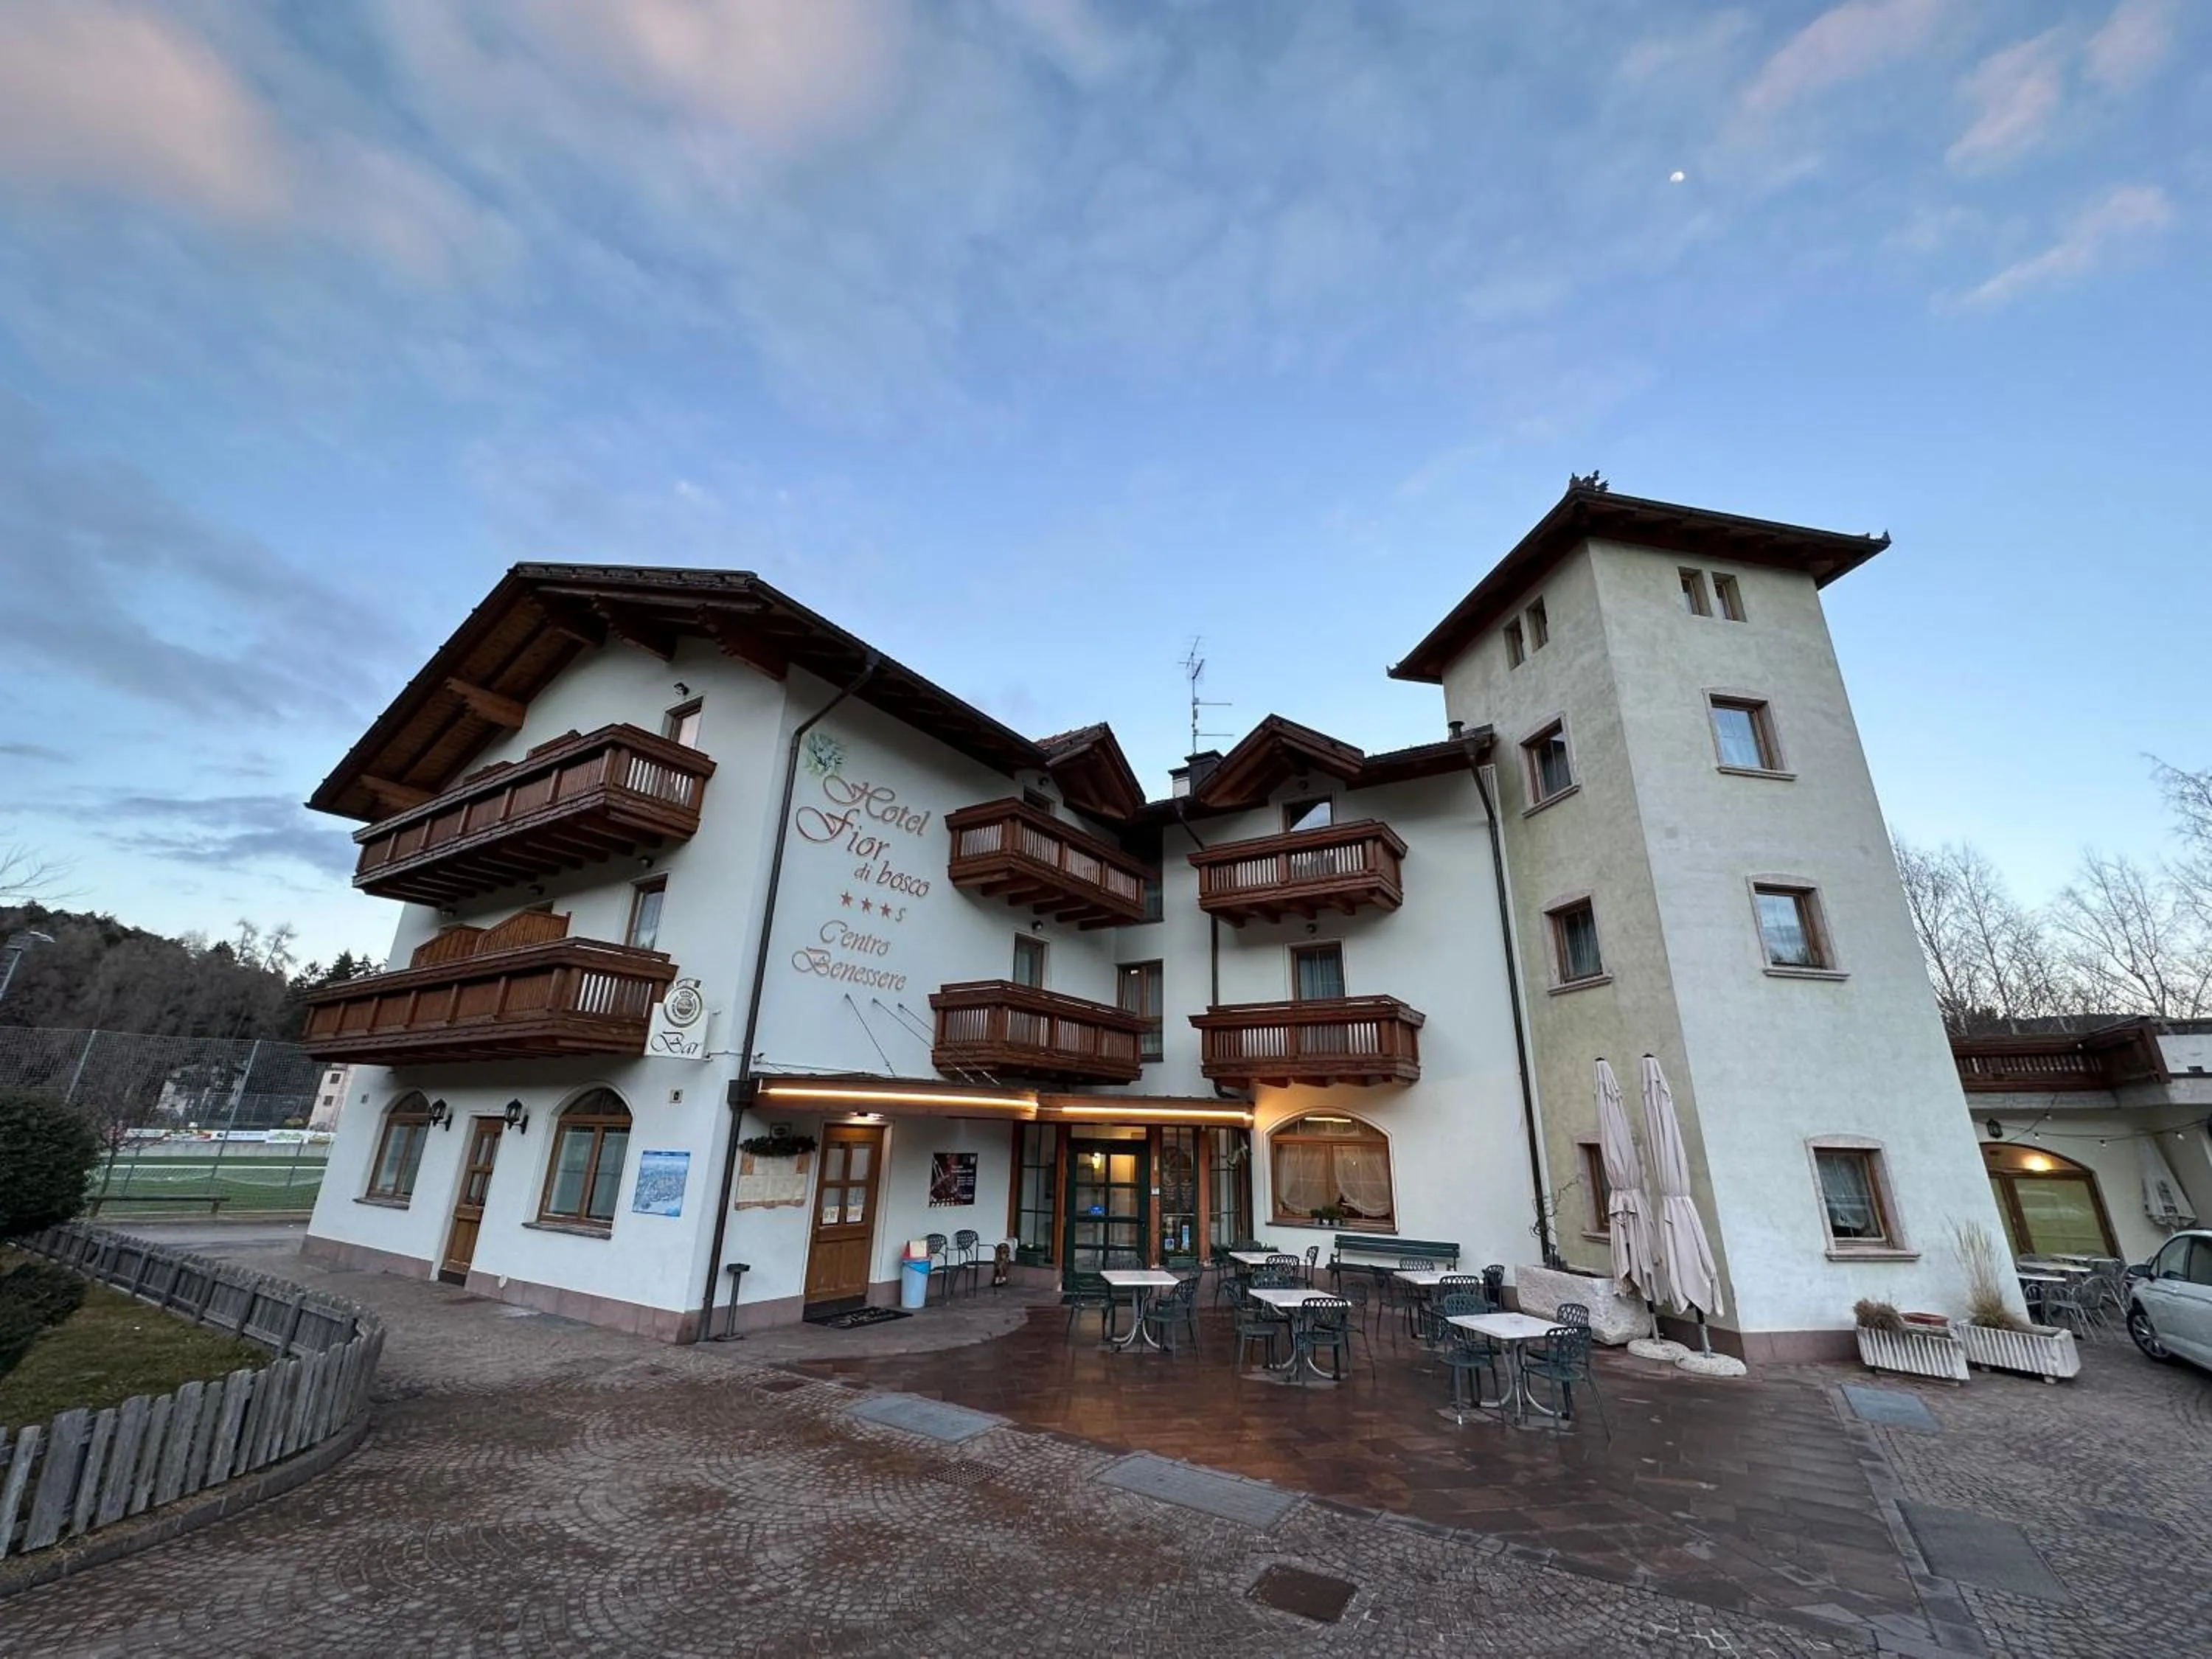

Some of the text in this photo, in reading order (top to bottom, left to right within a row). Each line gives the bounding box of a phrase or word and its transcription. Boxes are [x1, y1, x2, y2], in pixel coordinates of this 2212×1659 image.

[823, 775, 931, 837] Hotel
[796, 806, 890, 861] Fior
[854, 860, 931, 899] di bosco
[819, 919, 891, 957] Centro
[791, 947, 907, 992] Benessere
[650, 1032, 701, 1054] Bar
